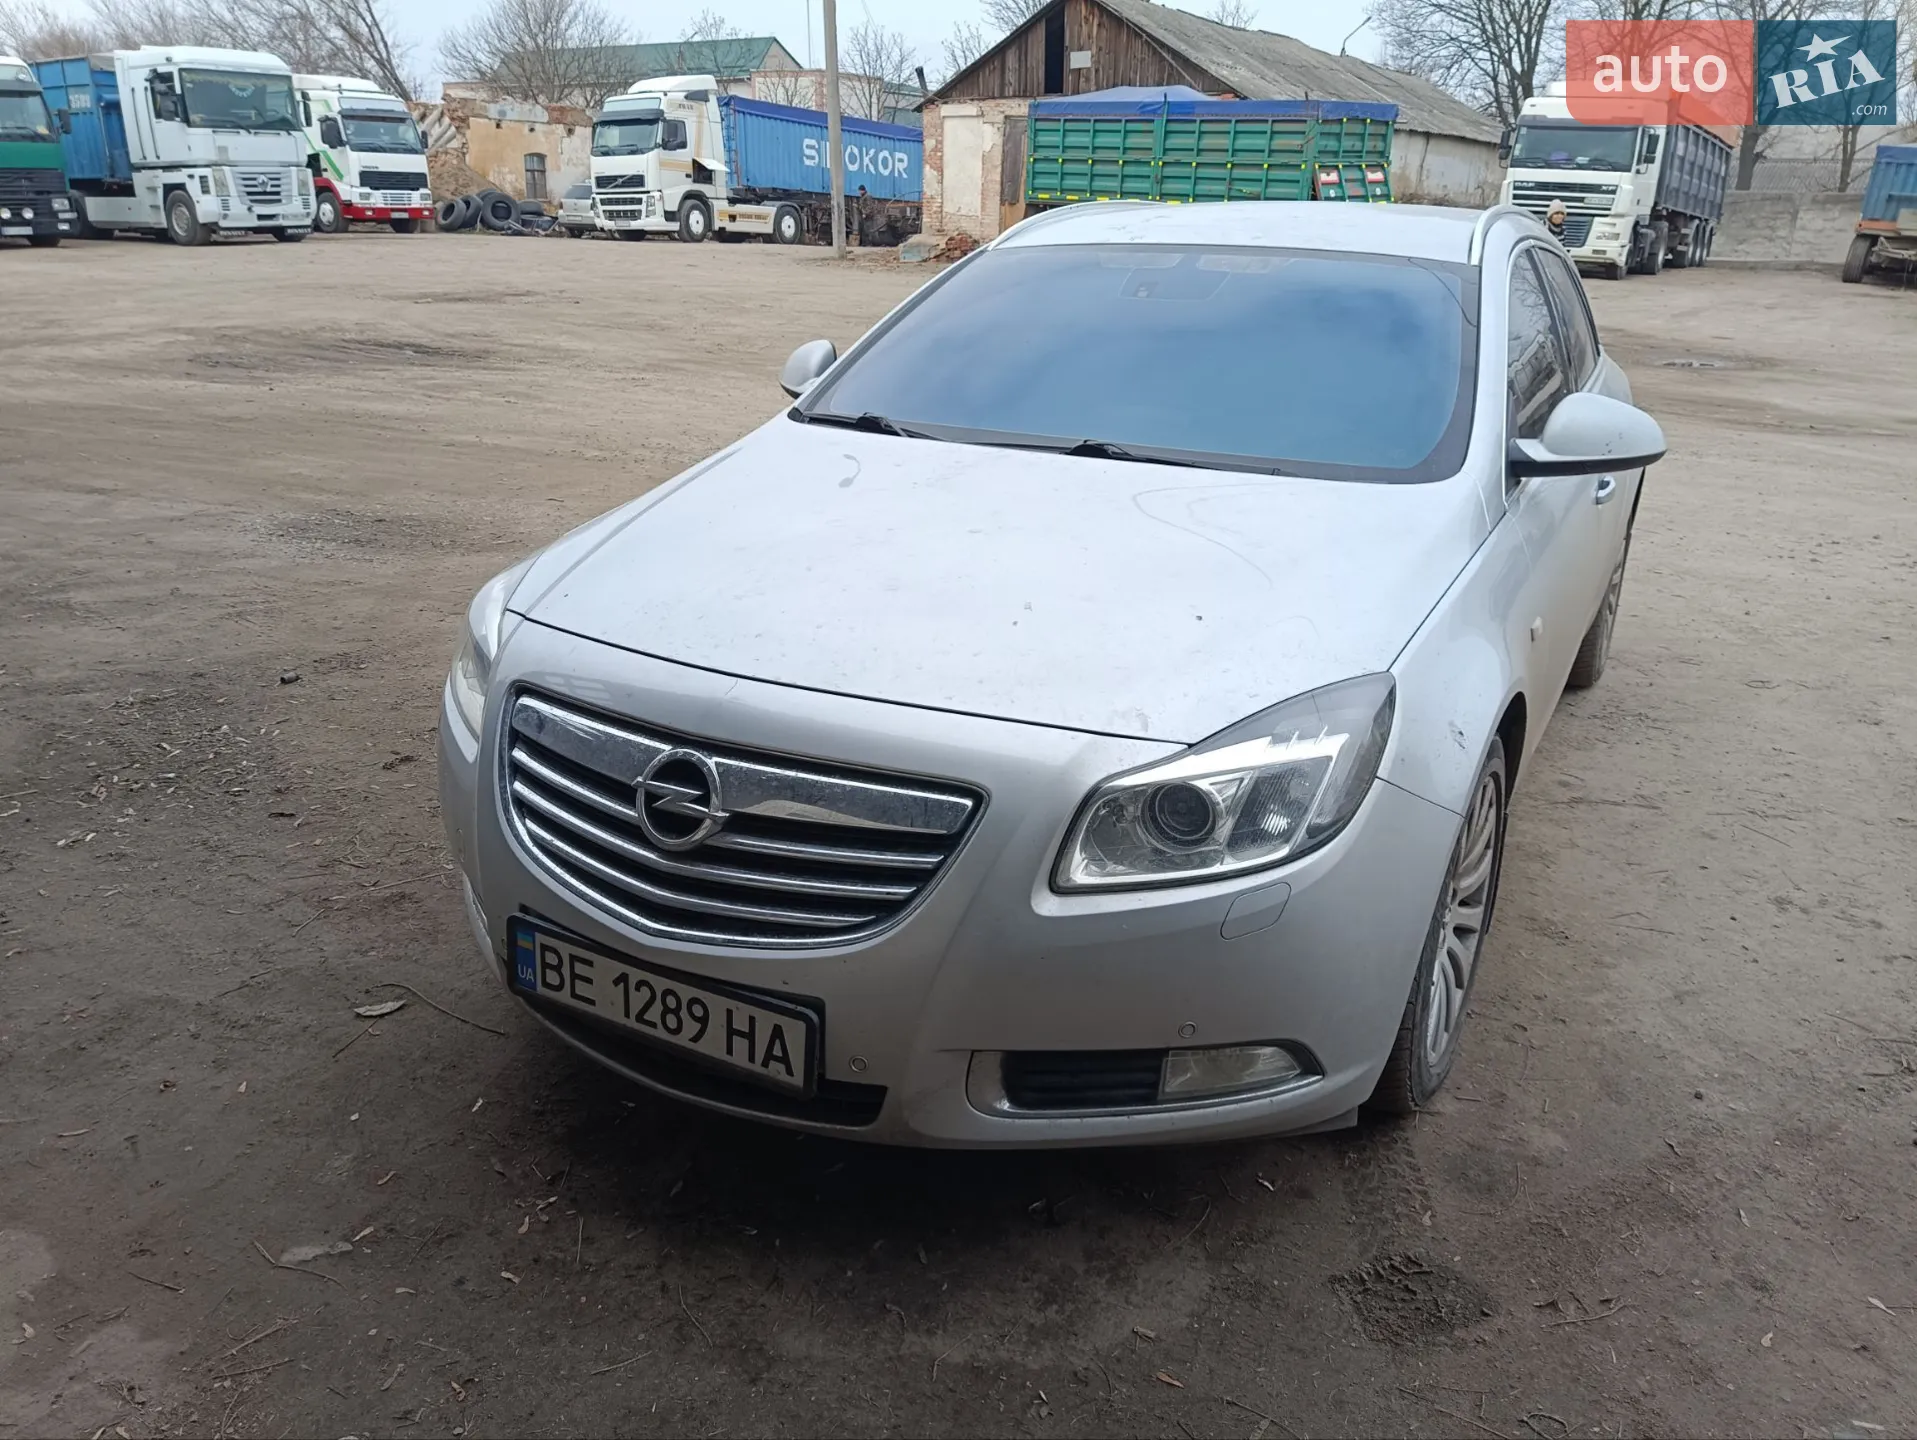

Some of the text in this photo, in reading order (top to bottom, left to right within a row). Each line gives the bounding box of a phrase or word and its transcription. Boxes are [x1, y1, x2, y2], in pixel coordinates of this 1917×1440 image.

[661, 750, 710, 773] OPEL
[517, 962, 535, 983] UA
[540, 942, 795, 1078] BE 1289 HA
